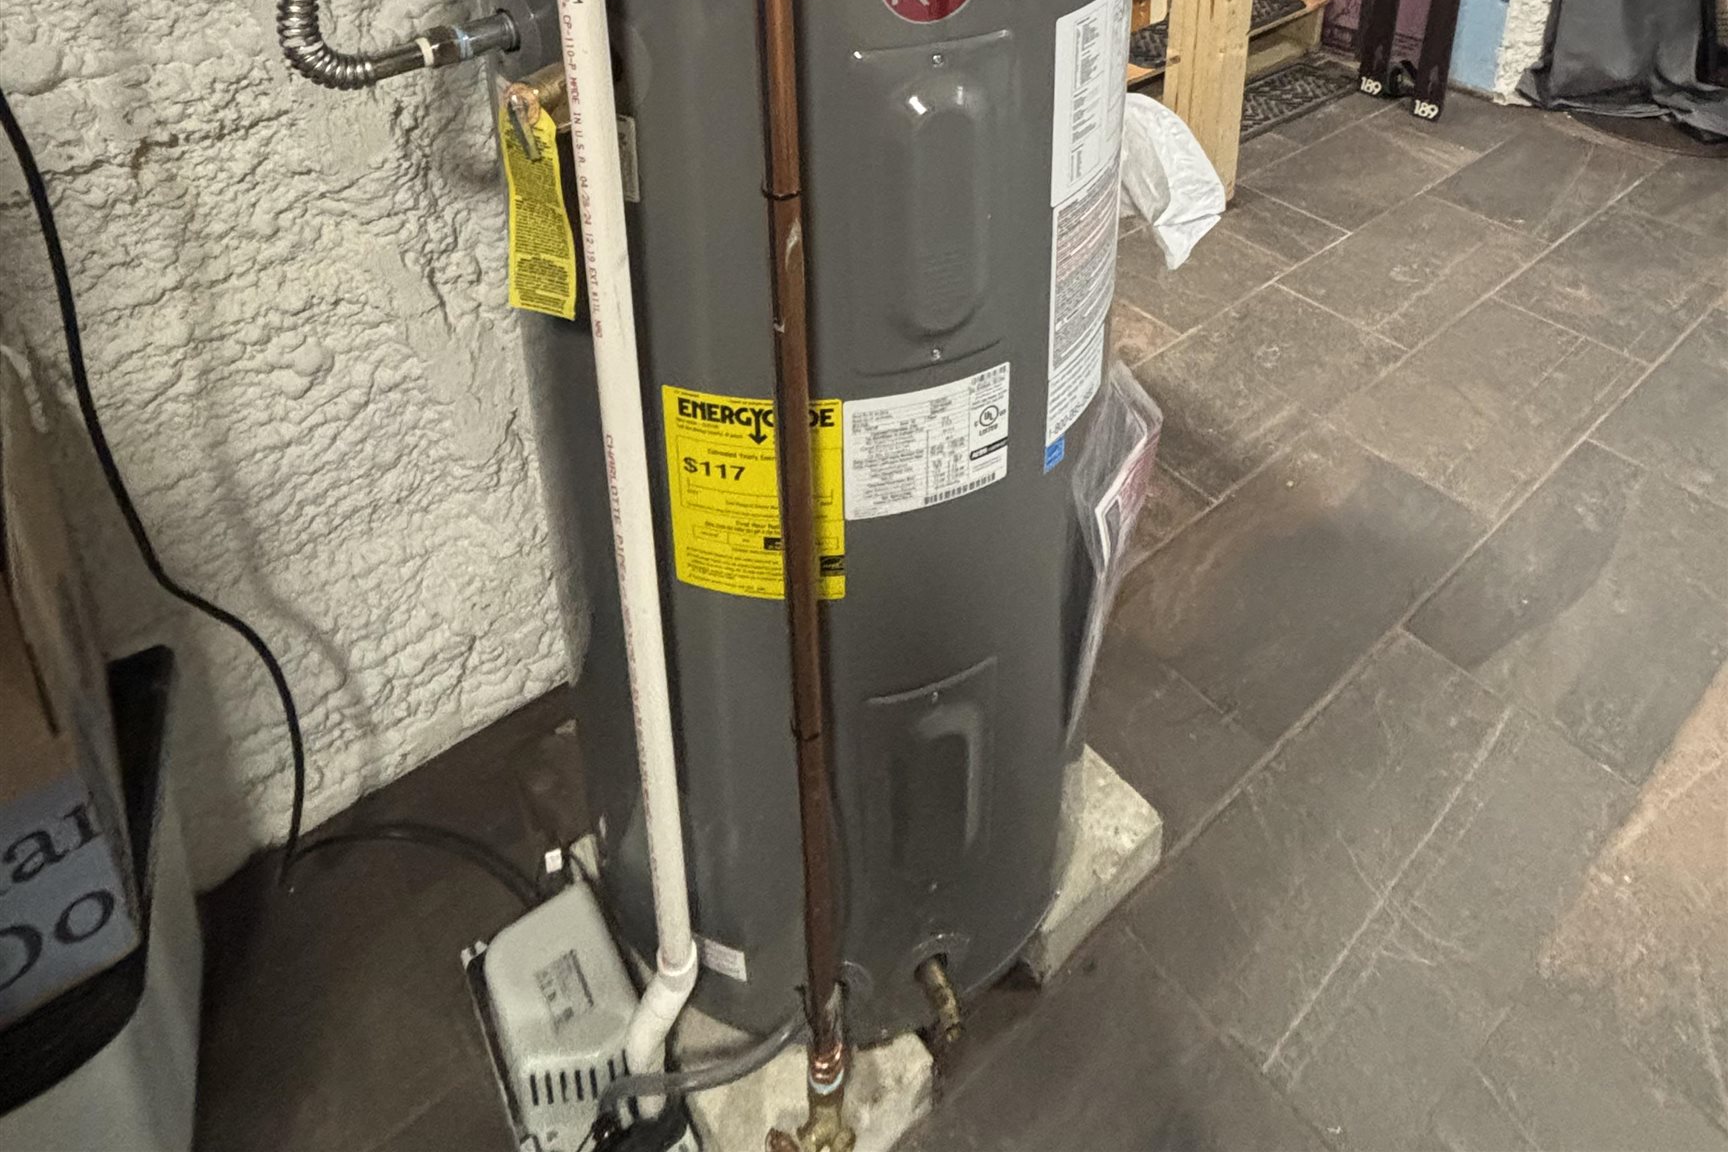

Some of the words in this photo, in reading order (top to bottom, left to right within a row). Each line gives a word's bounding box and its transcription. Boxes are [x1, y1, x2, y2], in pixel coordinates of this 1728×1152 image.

[569, 76, 580, 105] MADE
[1360, 76, 1382, 95] 189
[573, 112, 583, 125] IN
[1414, 99, 1439, 119] 189
[683, 456, 746, 481] $117
[605, 433, 623, 527] CHARLOTTE
